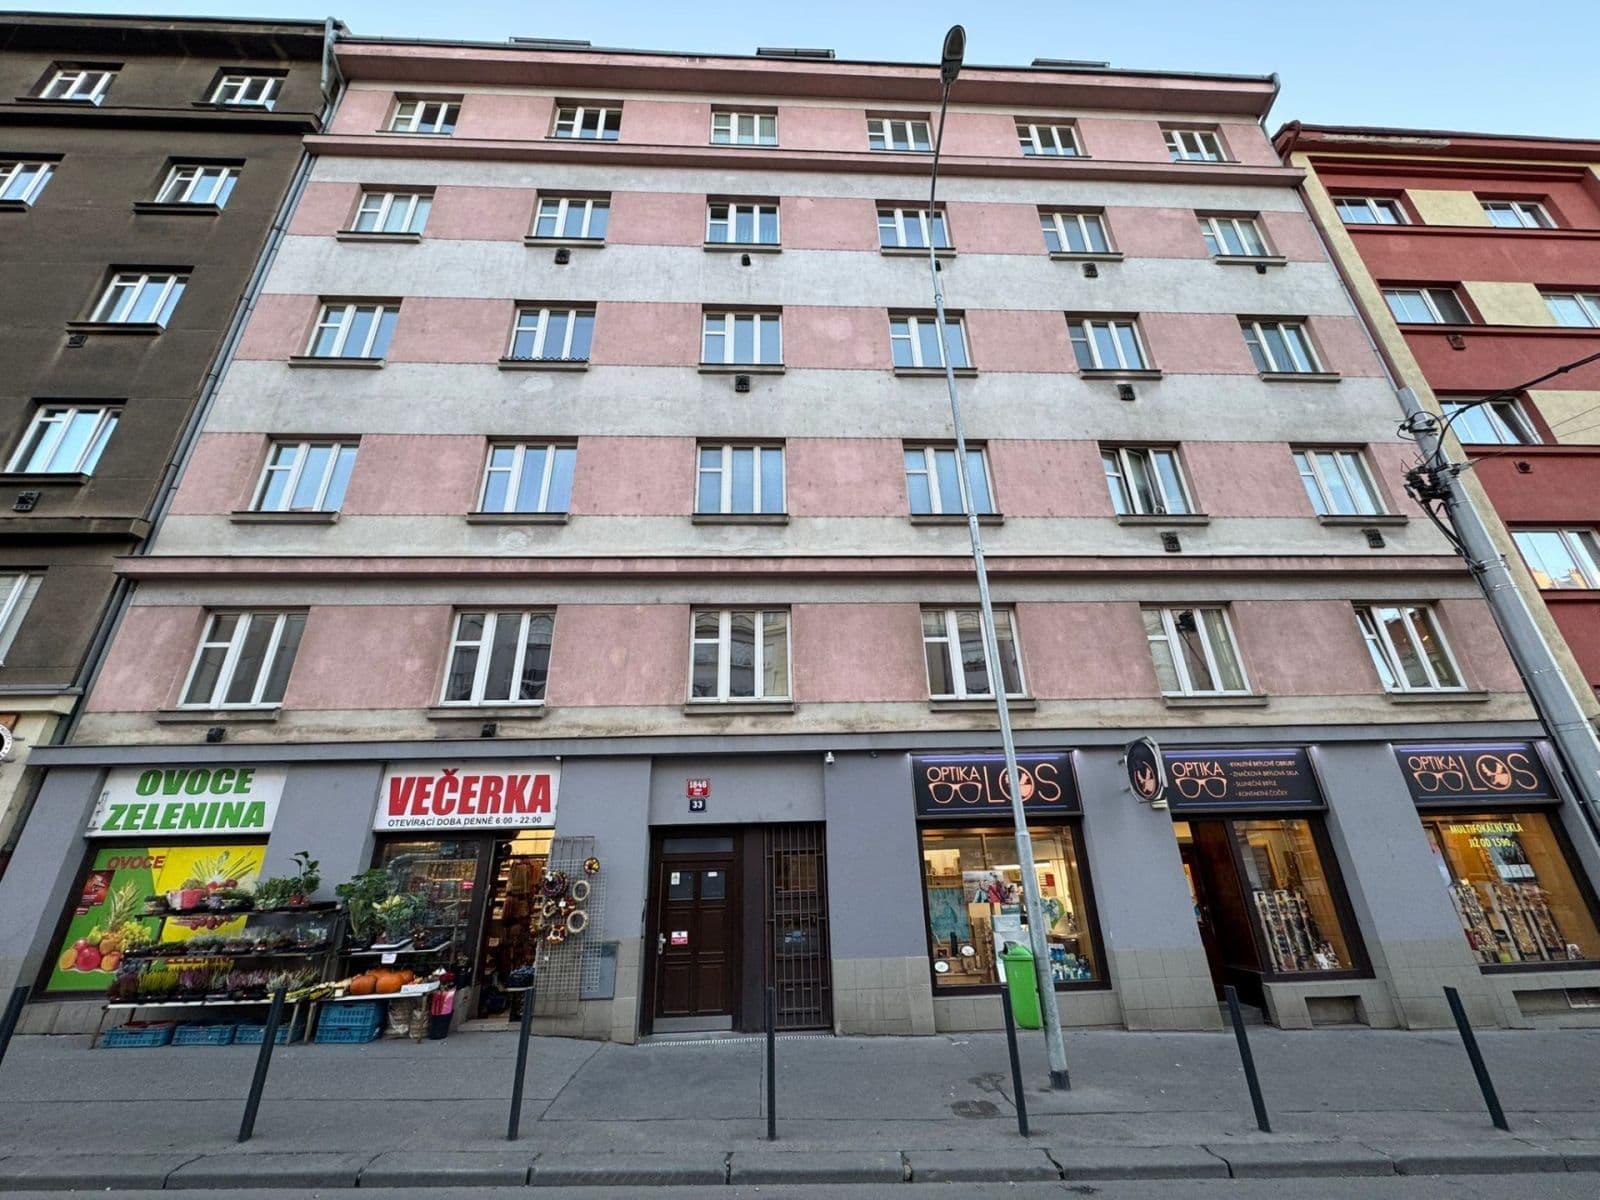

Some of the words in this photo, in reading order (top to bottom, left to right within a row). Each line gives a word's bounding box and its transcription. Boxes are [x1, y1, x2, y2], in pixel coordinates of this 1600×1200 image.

[926, 765, 981, 782] OPTIKA
[1171, 761, 1225, 778] OPTIKA
[1408, 755, 1461, 771] OPTIKA
[1458, 753, 1538, 790] LOS
[135, 767, 257, 796] OVOCE
[388, 768, 552, 816] VEČERKA
[692, 800, 703, 809] 33
[101, 801, 266, 831] ZELENINA
[388, 817, 435, 827] OTEVÍRACÍ
[437, 816, 462, 826] DOBA
[464, 815, 494, 825] DENNĚ
[495, 816, 513, 825] 6:00
[519, 816, 542, 824] 22:00
[1449, 822, 1504, 834] MULTIFOKÁLNÍ
[1503, 822, 1524, 833] SKLA
[1468, 837, 1480, 848] JIŽ
[1480, 838, 1491, 847] OD
[107, 855, 166, 870] OVOCE
